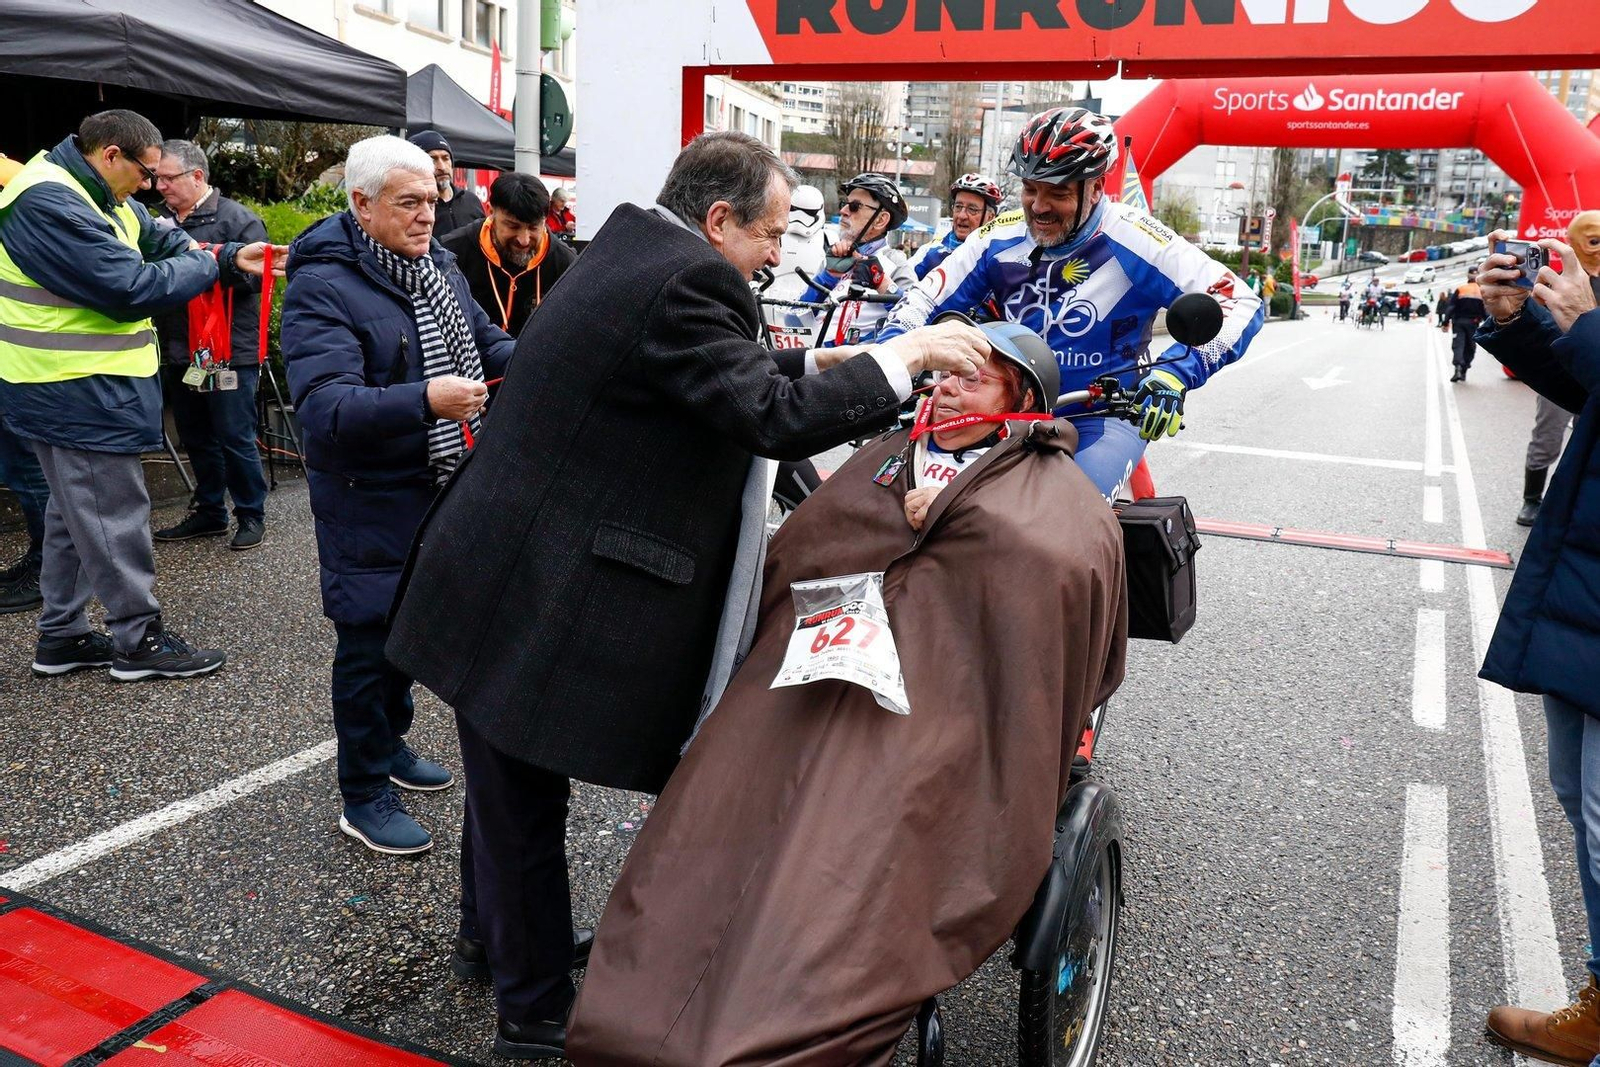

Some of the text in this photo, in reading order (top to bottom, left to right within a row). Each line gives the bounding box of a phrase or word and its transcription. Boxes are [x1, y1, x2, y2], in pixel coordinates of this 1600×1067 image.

[1212, 86, 1464, 115] Sports Santander
[1286, 121, 1370, 131] sportssantander.es
[1544, 207, 1581, 221] Sport
[774, 334, 806, 350] 516
[810, 616, 881, 654] 627
